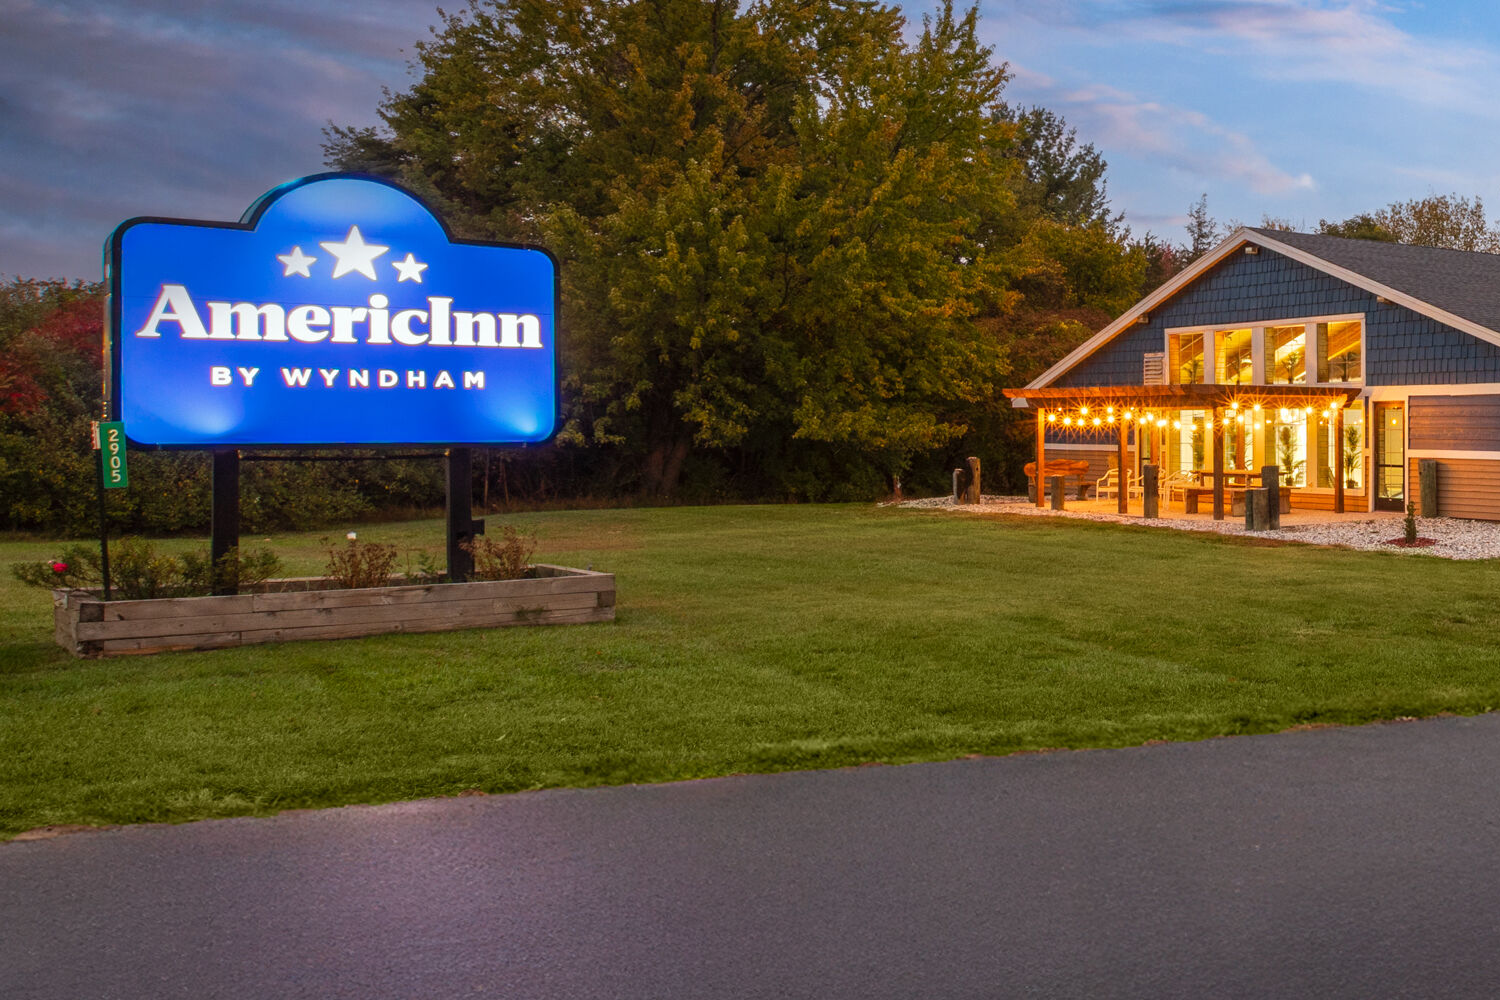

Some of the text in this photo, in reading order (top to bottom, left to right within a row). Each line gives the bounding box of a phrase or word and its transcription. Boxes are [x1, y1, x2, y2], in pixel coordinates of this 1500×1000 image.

[136, 284, 543, 349] AmericInn
[211, 367, 486, 389] BY WYNDHAM
[107, 428, 121, 483] 2905
